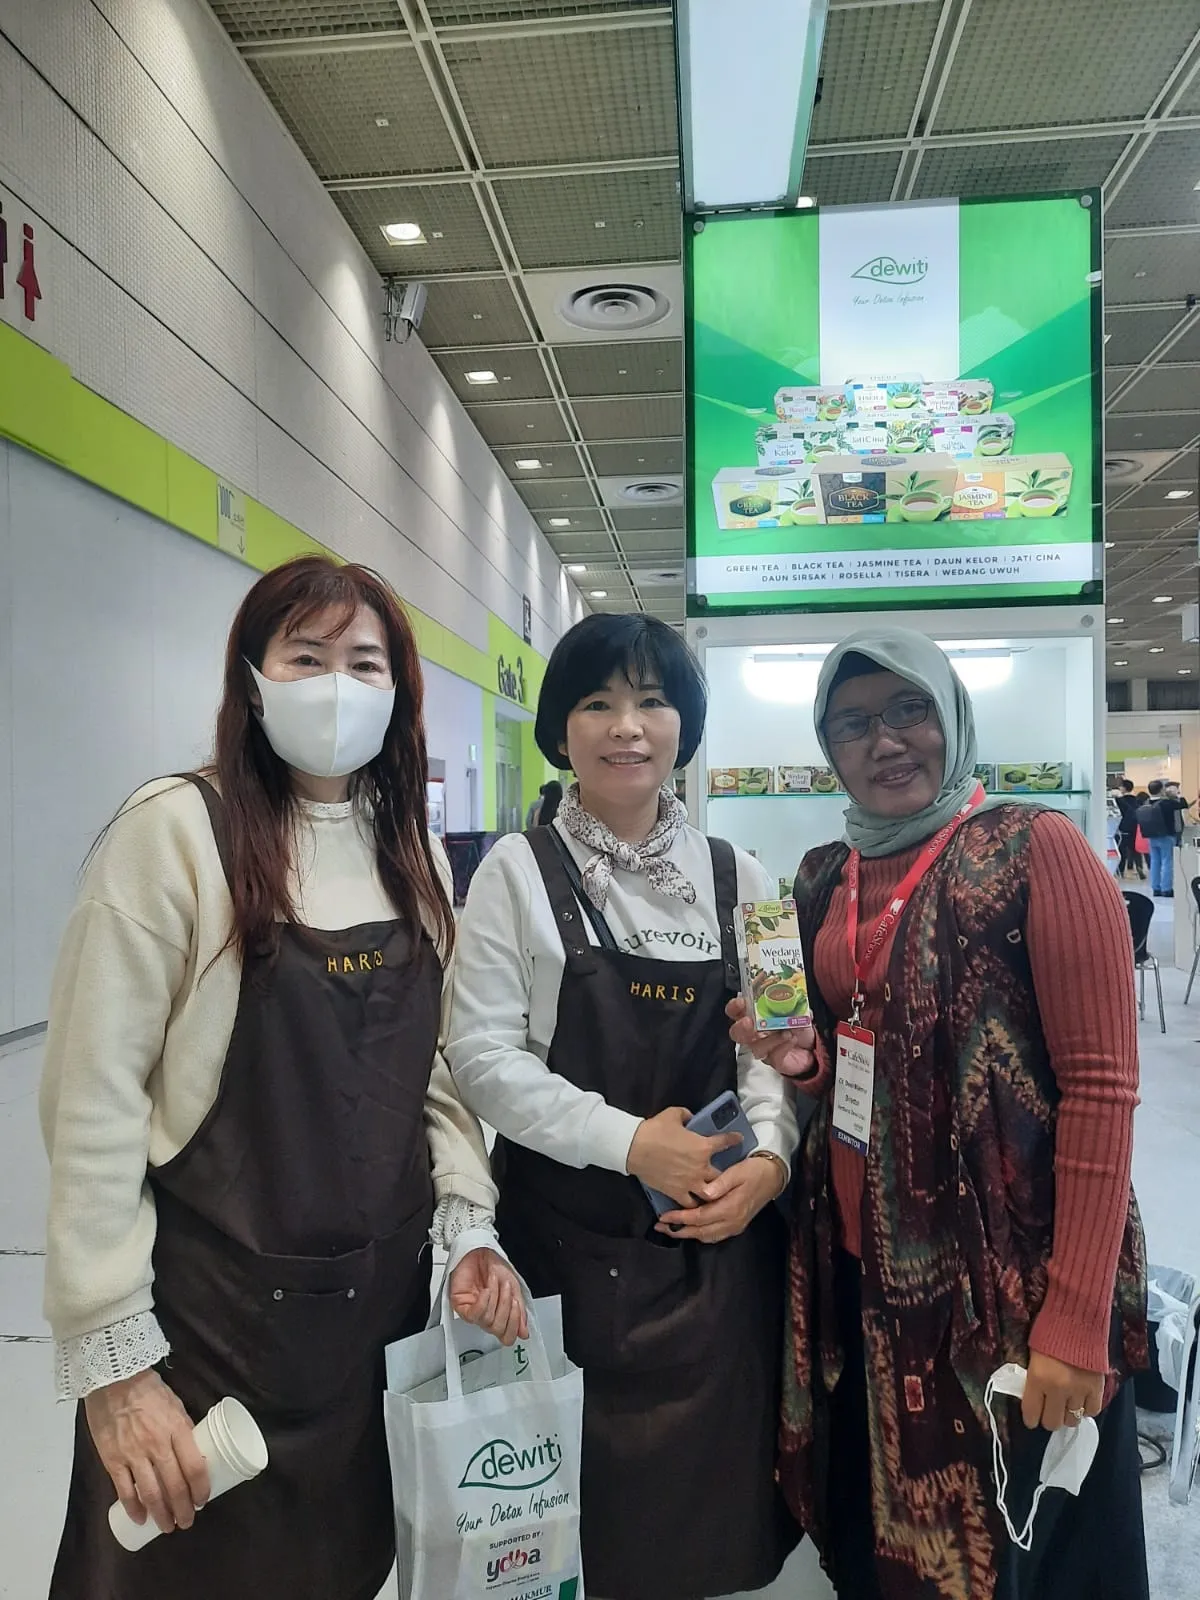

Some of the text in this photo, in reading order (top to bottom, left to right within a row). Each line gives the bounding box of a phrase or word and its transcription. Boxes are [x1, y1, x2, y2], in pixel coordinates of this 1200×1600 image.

[870, 256, 929, 277] dewiti
[838, 494, 869, 502] BLACK
[959, 493, 993, 501] JASMINE
[726, 564, 758, 573] GREEN
[791, 562, 823, 571] BLACK
[826, 561, 845, 569] TEA
[856, 559, 901, 568] JASMINE
[904, 559, 922, 567] TEA
[934, 558, 962, 566] DAUN
[966, 556, 998, 565] KELOR
[1011, 554, 1032, 563] JATI
[1036, 553, 1061, 562] CINA
[761, 566, 1020, 583] DAUN SIRSAK ROSELLA TISERA WEDANG UWUH
[498, 654, 524, 703] Gate 3
[619, 929, 718, 956] urevoir
[762, 948, 800, 959] Wedang
[630, 981, 696, 1003] HARIS
[481, 1433, 563, 1480] dewiti
[456, 1489, 570, 1534] Your Detox Infusion
[489, 1534, 531, 1550] SUPPORTED
